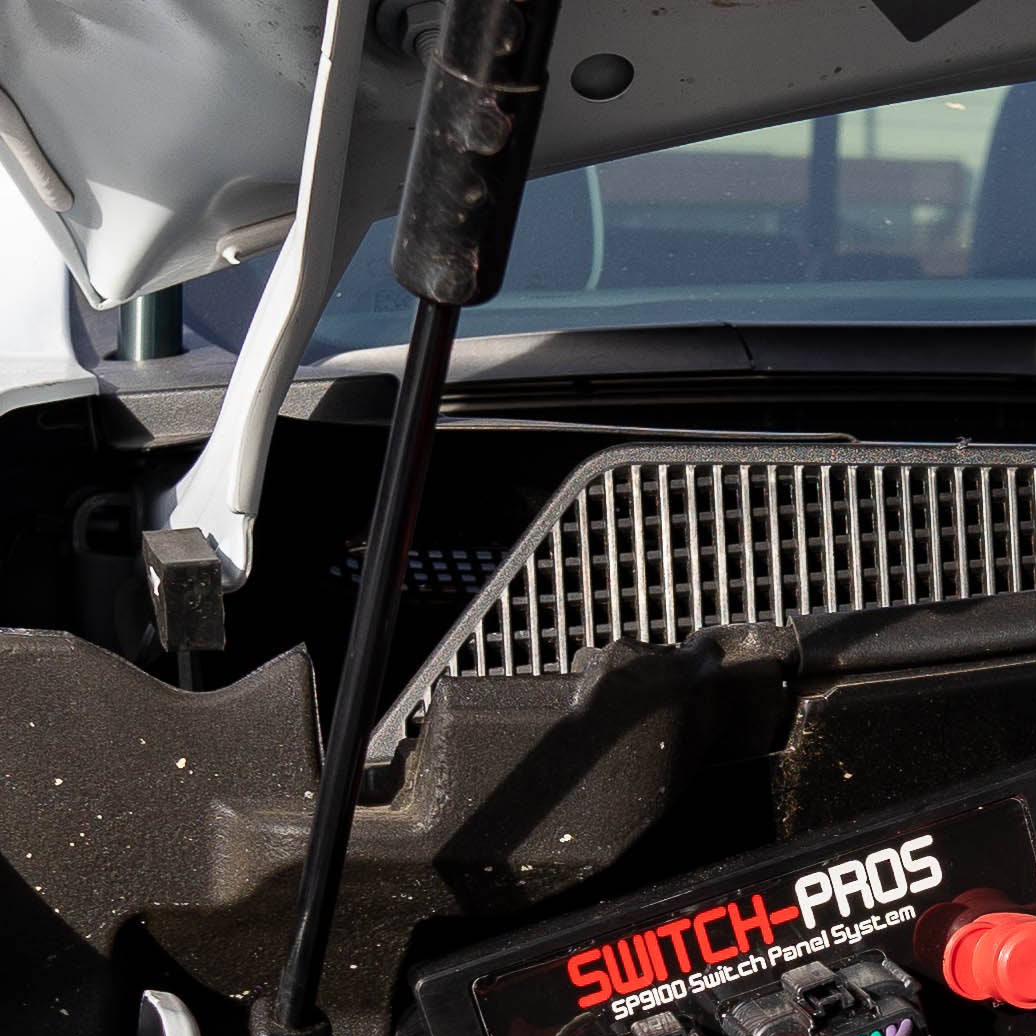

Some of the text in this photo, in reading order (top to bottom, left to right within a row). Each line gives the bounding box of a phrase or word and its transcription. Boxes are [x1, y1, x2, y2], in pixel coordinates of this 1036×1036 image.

[567, 834, 943, 1009] SWITCH-PROS
[610, 904, 917, 1021] SP9100 Switch Panel System
